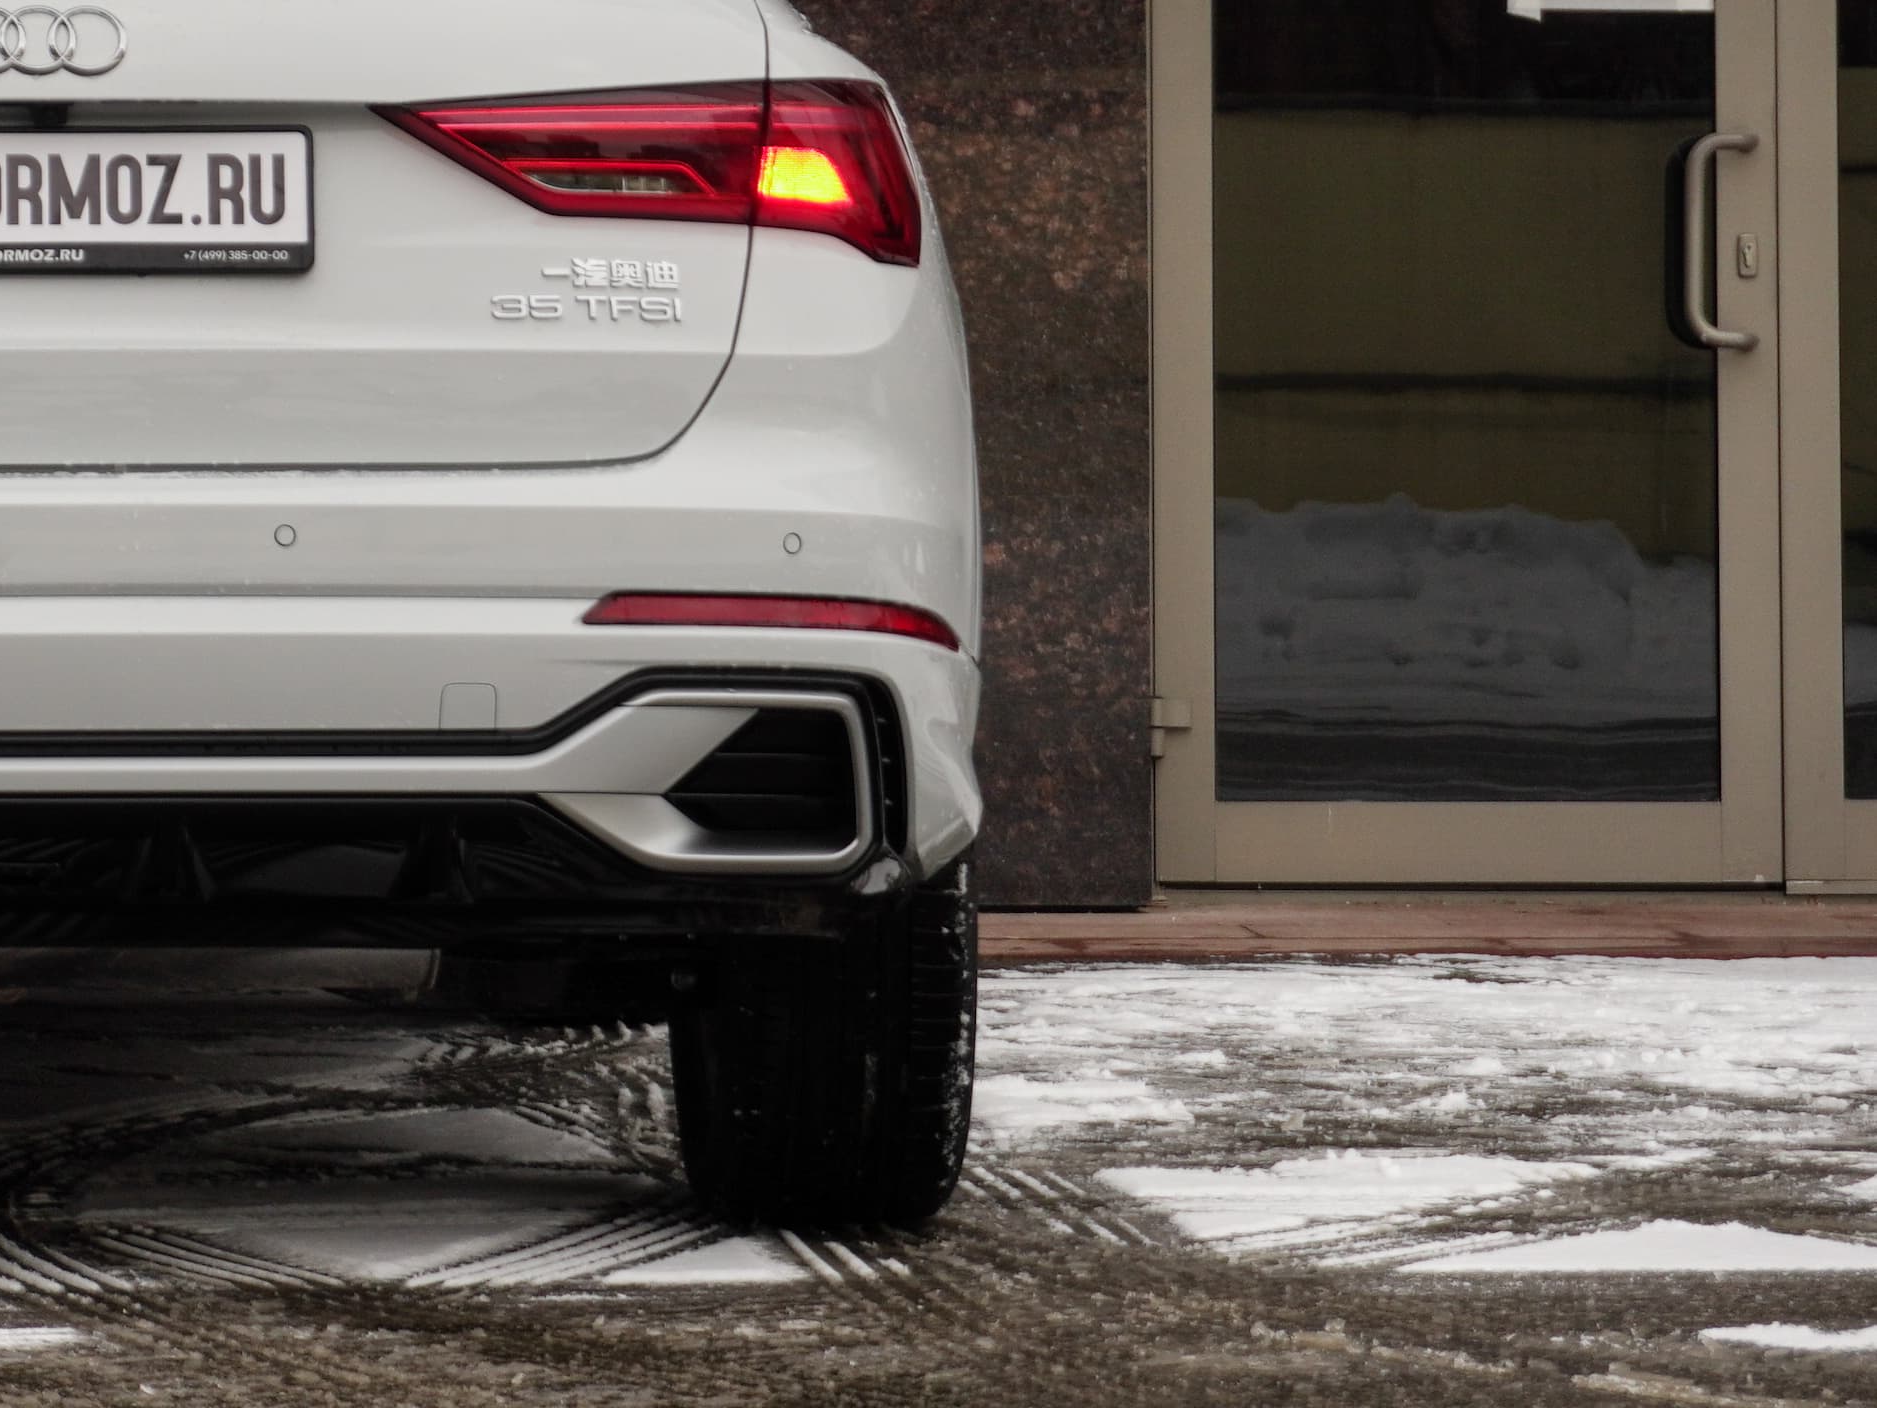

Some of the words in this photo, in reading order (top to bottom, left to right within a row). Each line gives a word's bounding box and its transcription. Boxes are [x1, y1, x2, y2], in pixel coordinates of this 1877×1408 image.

[541, 258, 680, 289] 一汽奥迪
[490, 294, 563, 320] 35
[575, 295, 682, 321] TFSI
